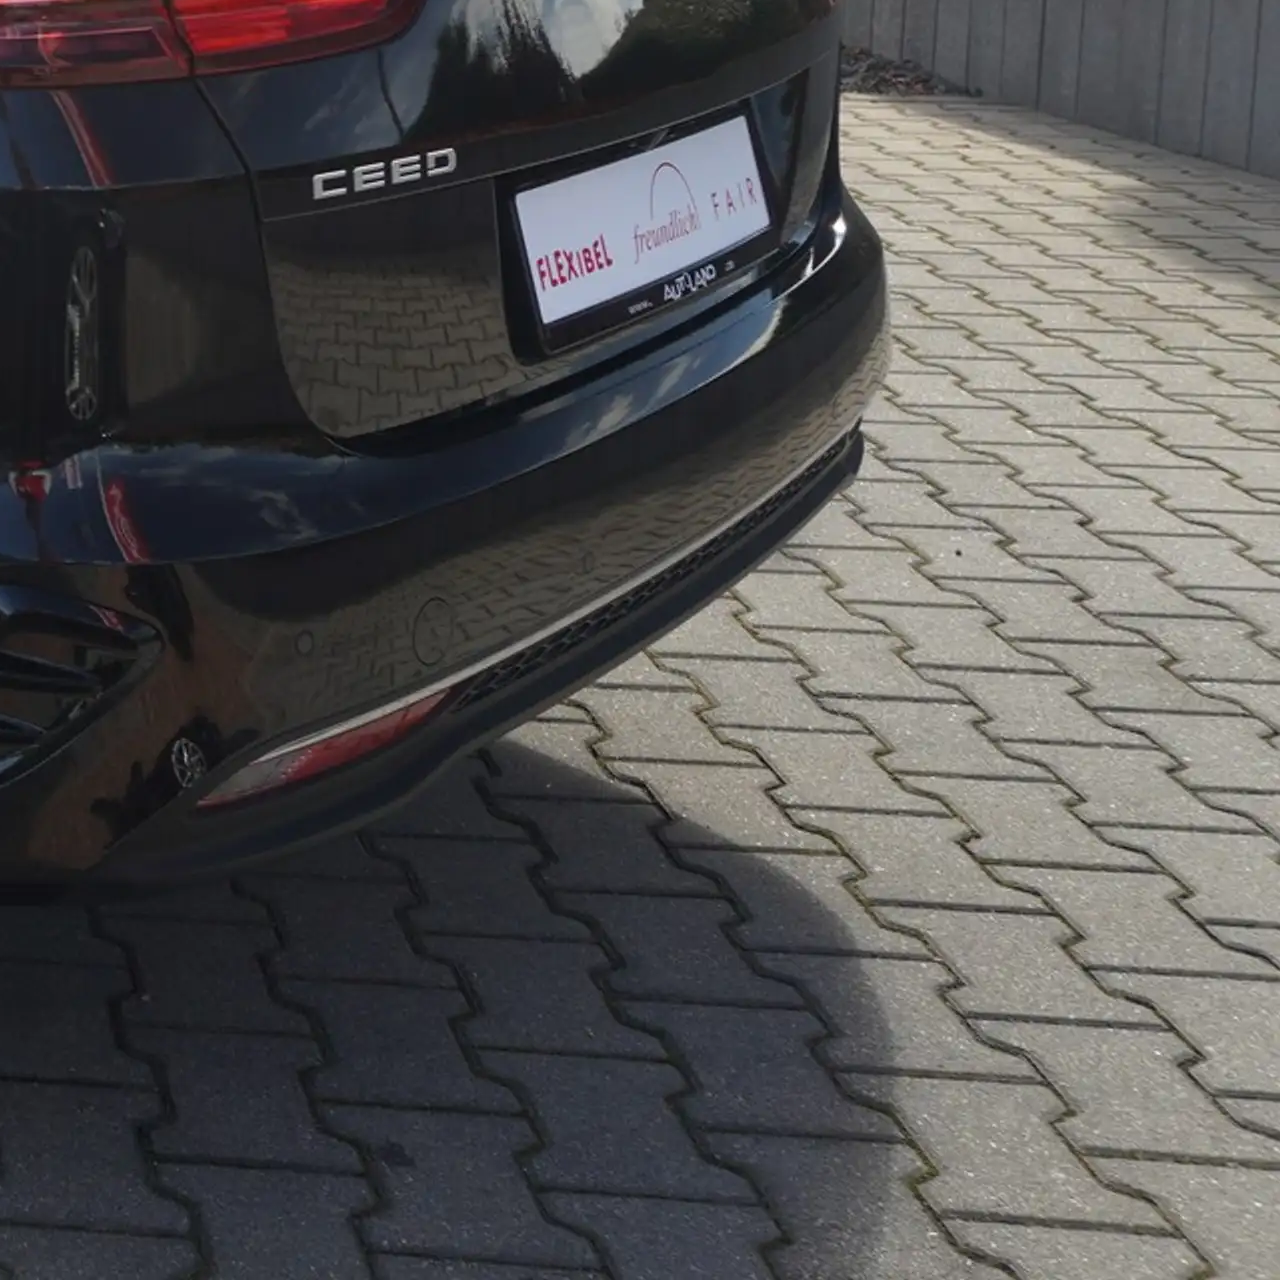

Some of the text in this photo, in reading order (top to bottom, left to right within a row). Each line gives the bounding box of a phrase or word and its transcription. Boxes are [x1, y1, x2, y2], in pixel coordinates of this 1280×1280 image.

[313, 148, 457, 201] CEED
[711, 177, 758, 221] FAIR
[536, 234, 614, 291] FLEXIBEL
